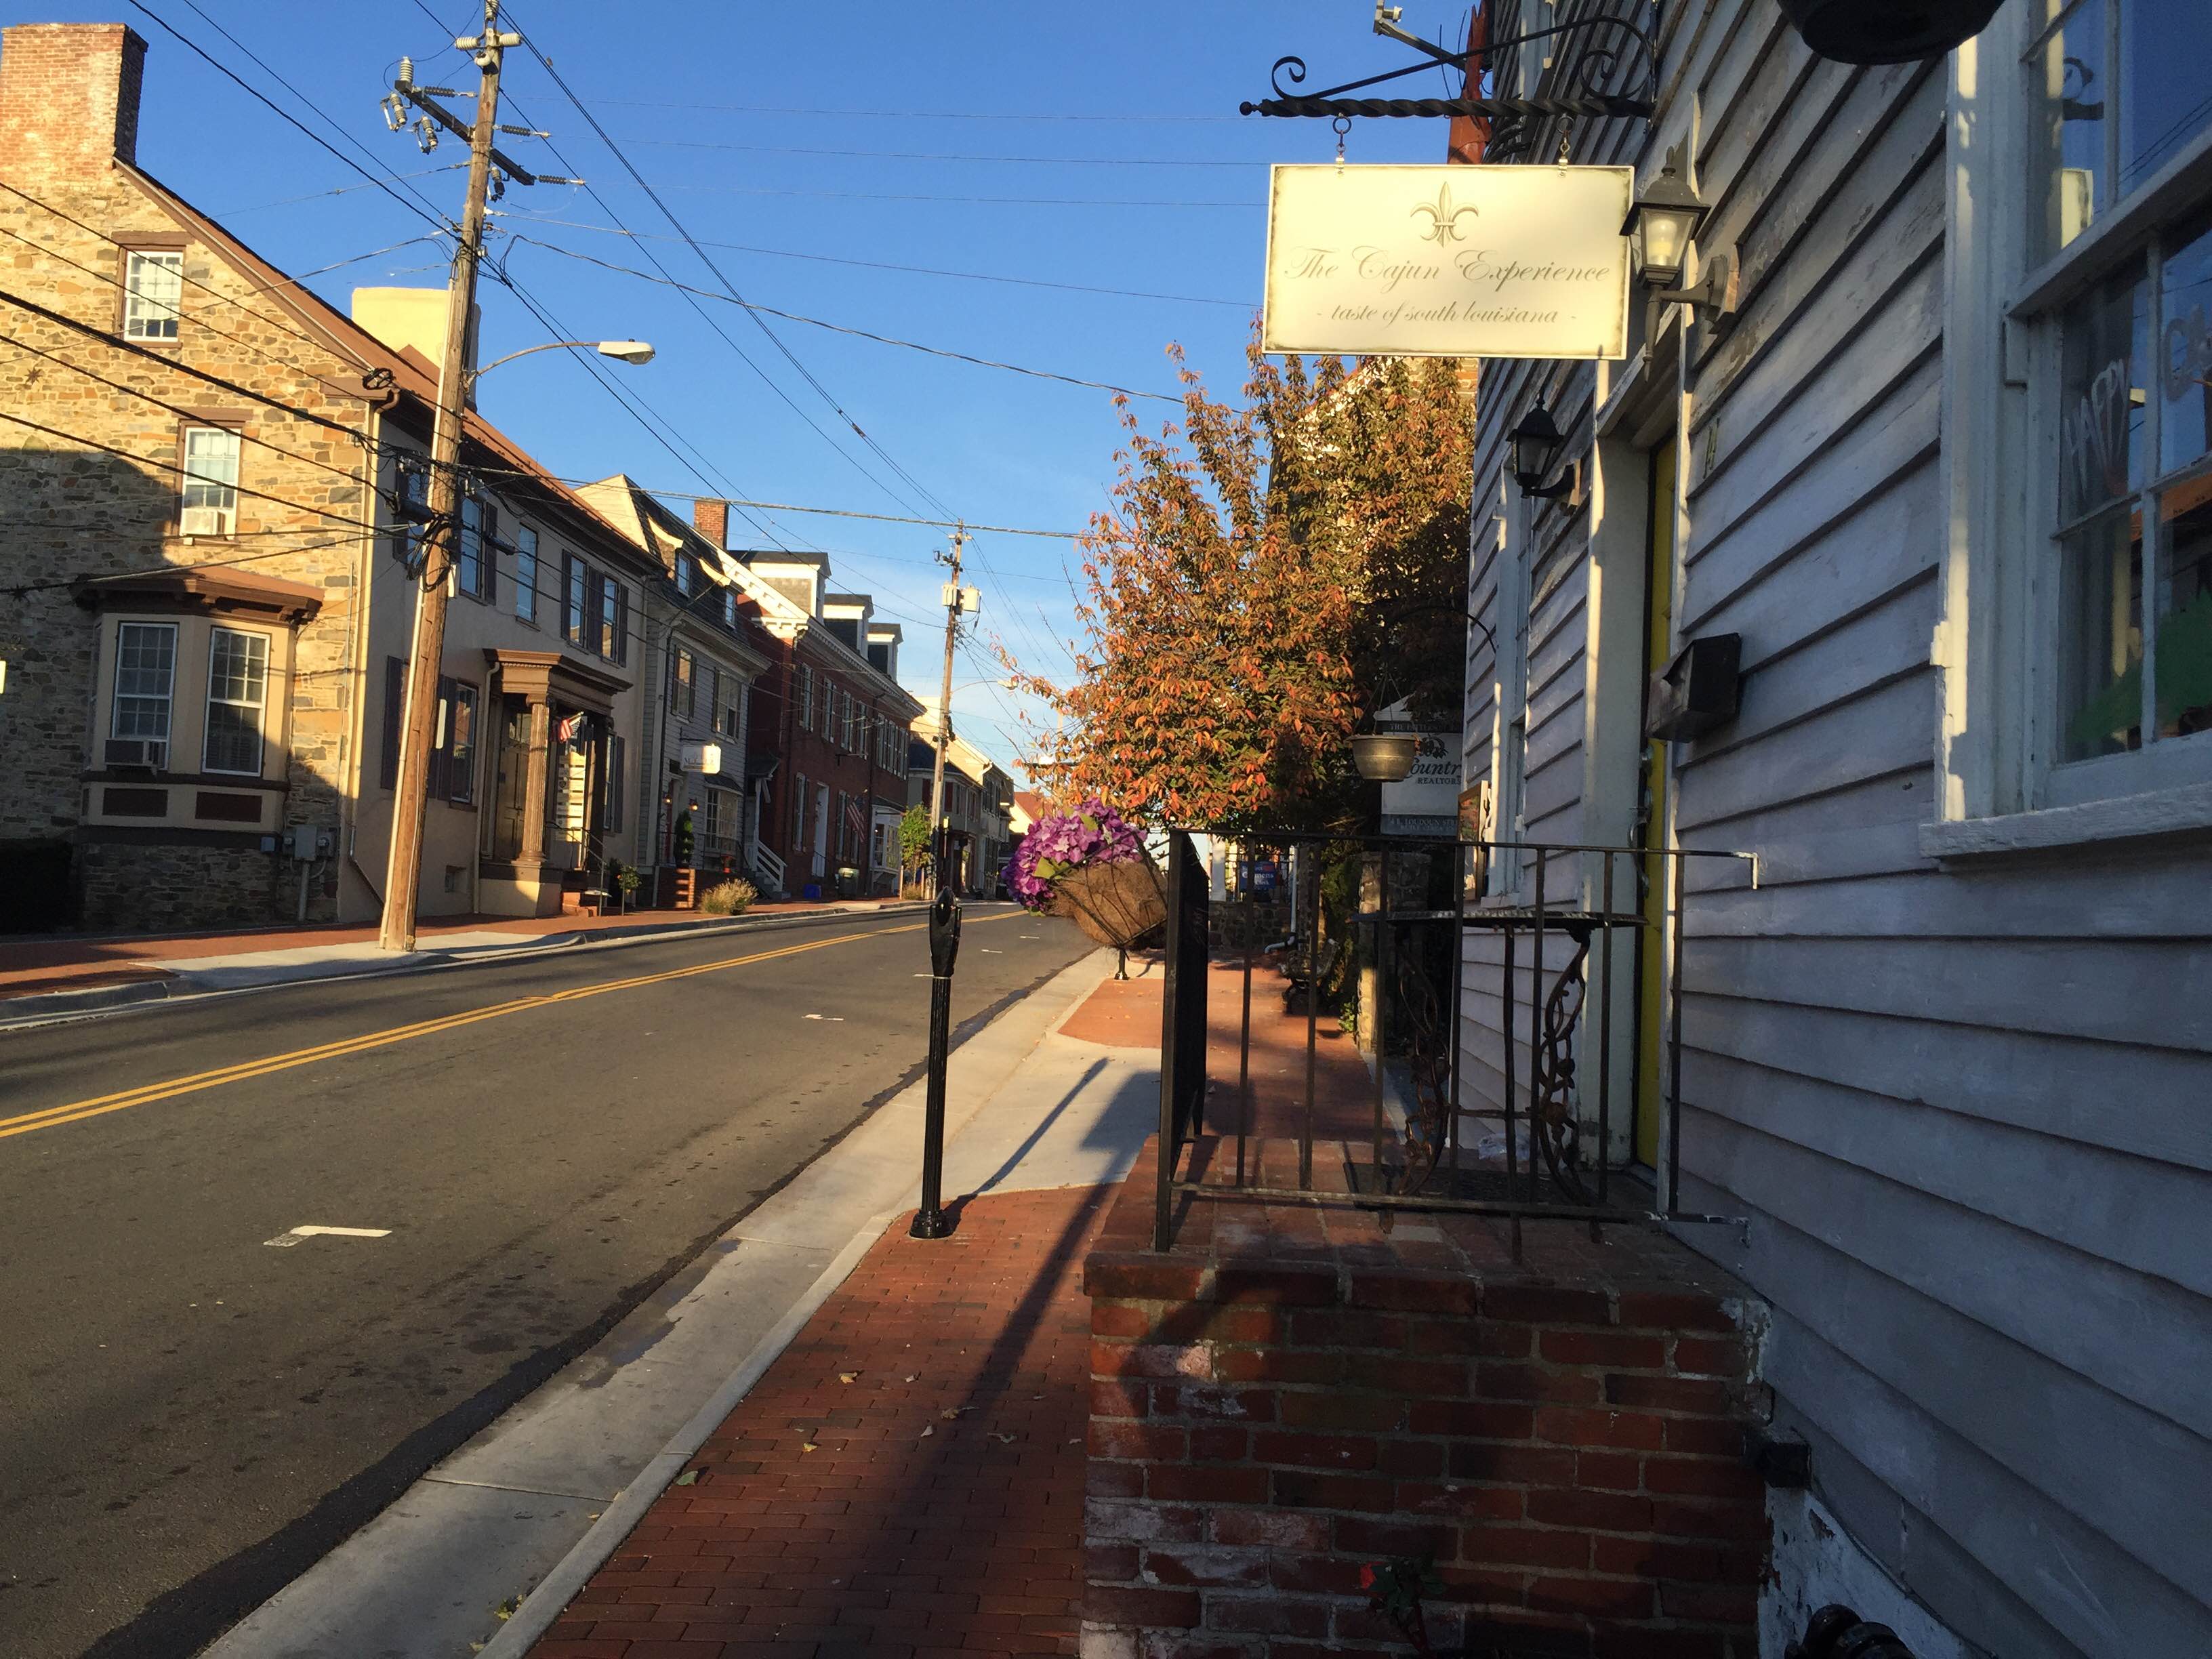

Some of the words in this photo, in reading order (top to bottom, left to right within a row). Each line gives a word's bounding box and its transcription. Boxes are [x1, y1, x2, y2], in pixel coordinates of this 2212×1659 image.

[1284, 246, 1339, 279] The
[1352, 246, 1440, 293] Cajun
[1454, 250, 1610, 292] Experience
[1331, 305, 1378, 321] taste
[1382, 300, 1410, 331] of
[1405, 301, 1459, 322] south
[1462, 301, 1559, 323] louisiana
[1406, 756, 1462, 778] ountr
